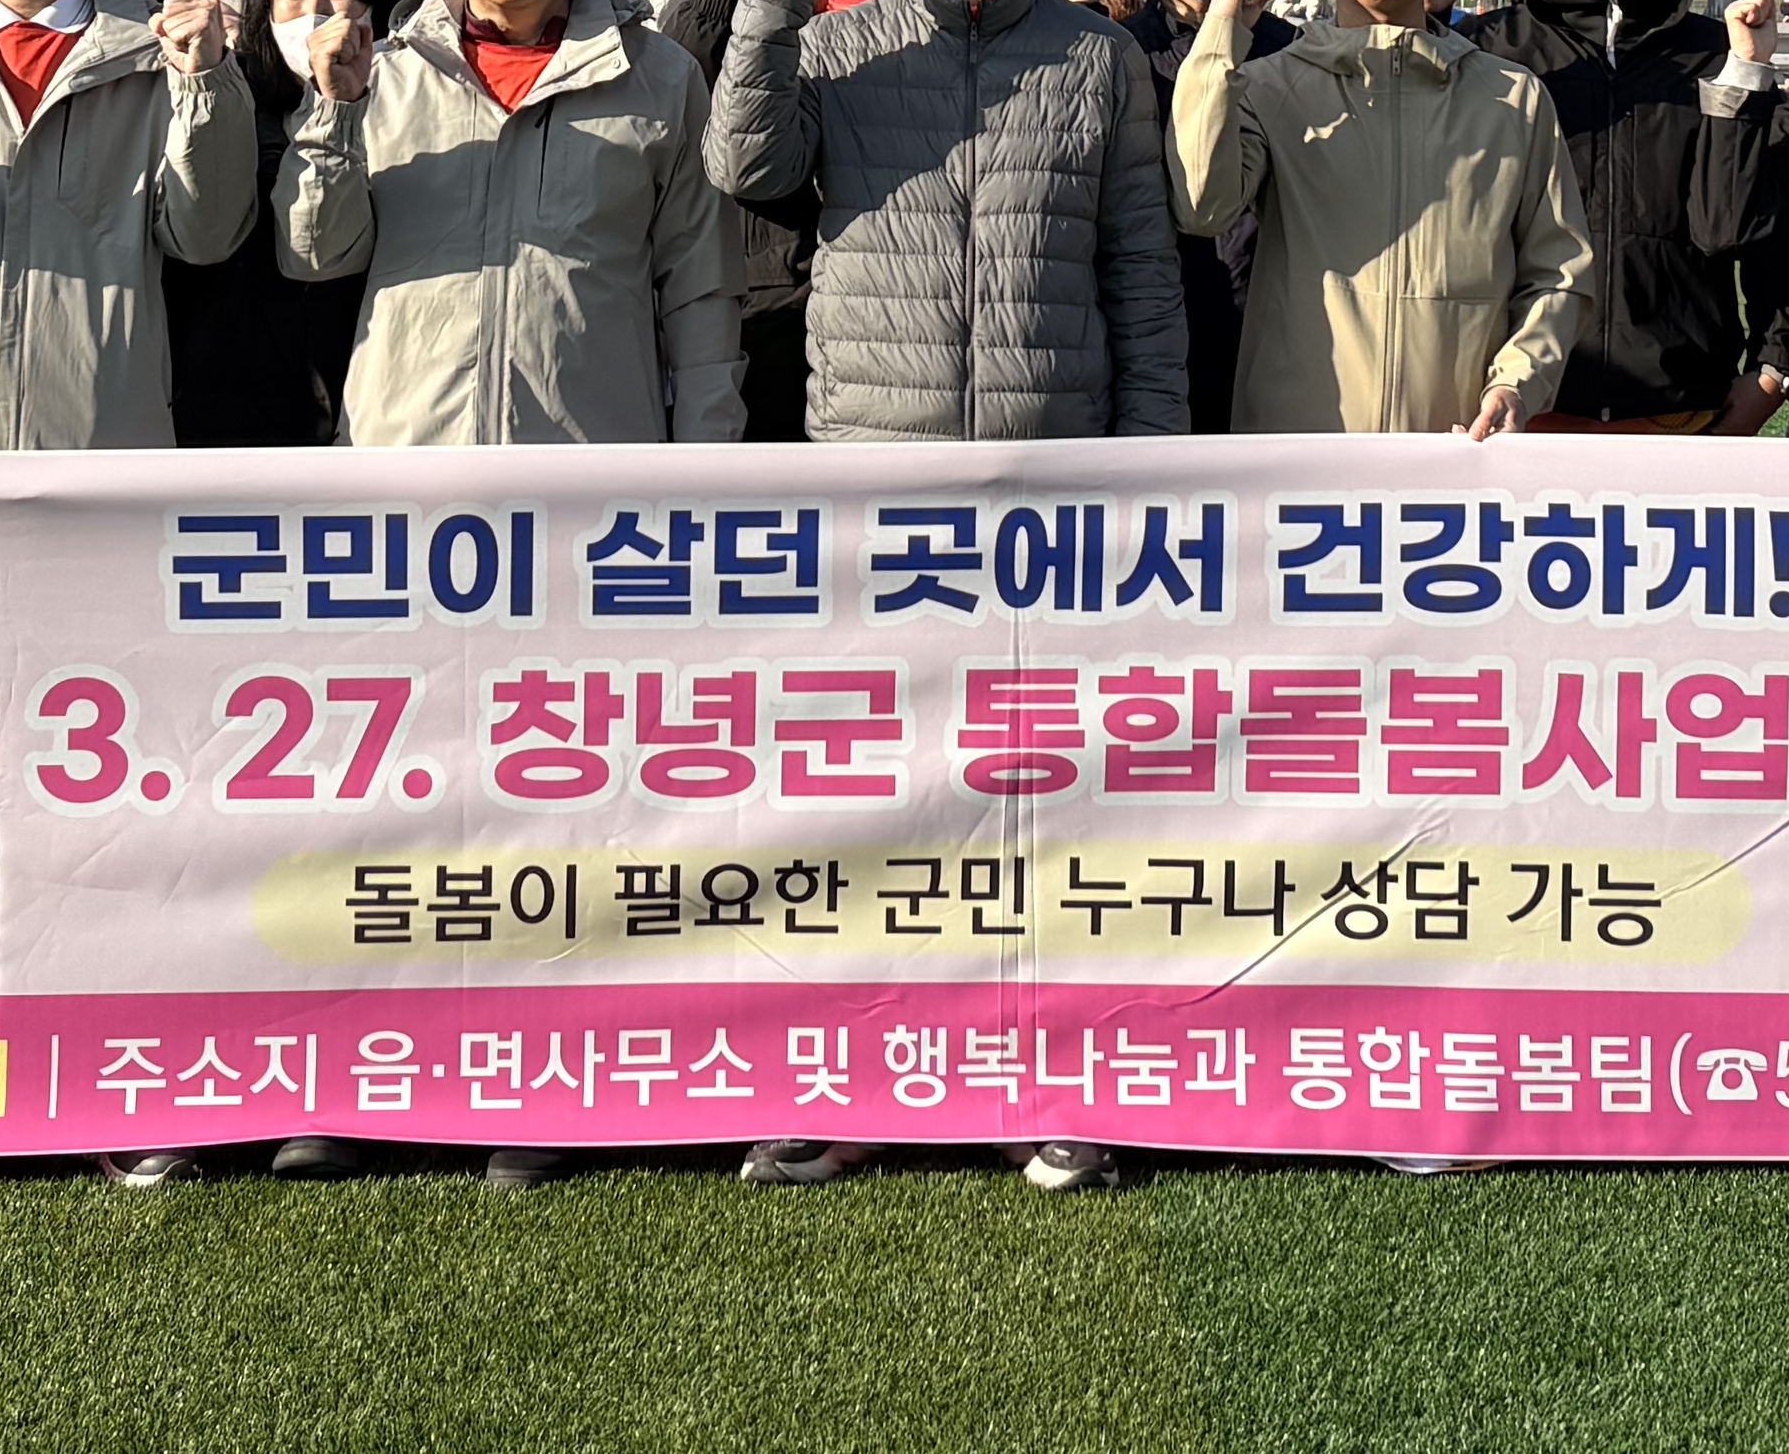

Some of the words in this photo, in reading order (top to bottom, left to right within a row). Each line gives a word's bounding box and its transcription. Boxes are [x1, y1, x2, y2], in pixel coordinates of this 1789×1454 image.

[171, 511, 534, 620] 군민이
[585, 508, 820, 616] 살던
[870, 503, 1226, 614] 곳에서
[36, 676, 173, 803] 3.
[224, 674, 434, 801] 27.
[489, 668, 904, 801] 창녕군
[344, 862, 579, 945] 돌봄이
[613, 857, 850, 939] 필요한
[875, 856, 1028, 937] 군민
[1059, 856, 1297, 938] 누구나
[1320, 854, 1481, 942] 상담
[1505, 861, 1663, 947] 가능
[94, 1031, 319, 1116] 주소지
[348, 1026, 757, 1113] 읍·면사무소
[785, 1025, 854, 1107] 및
[881, 1023, 1258, 1109] 행복나눔과
